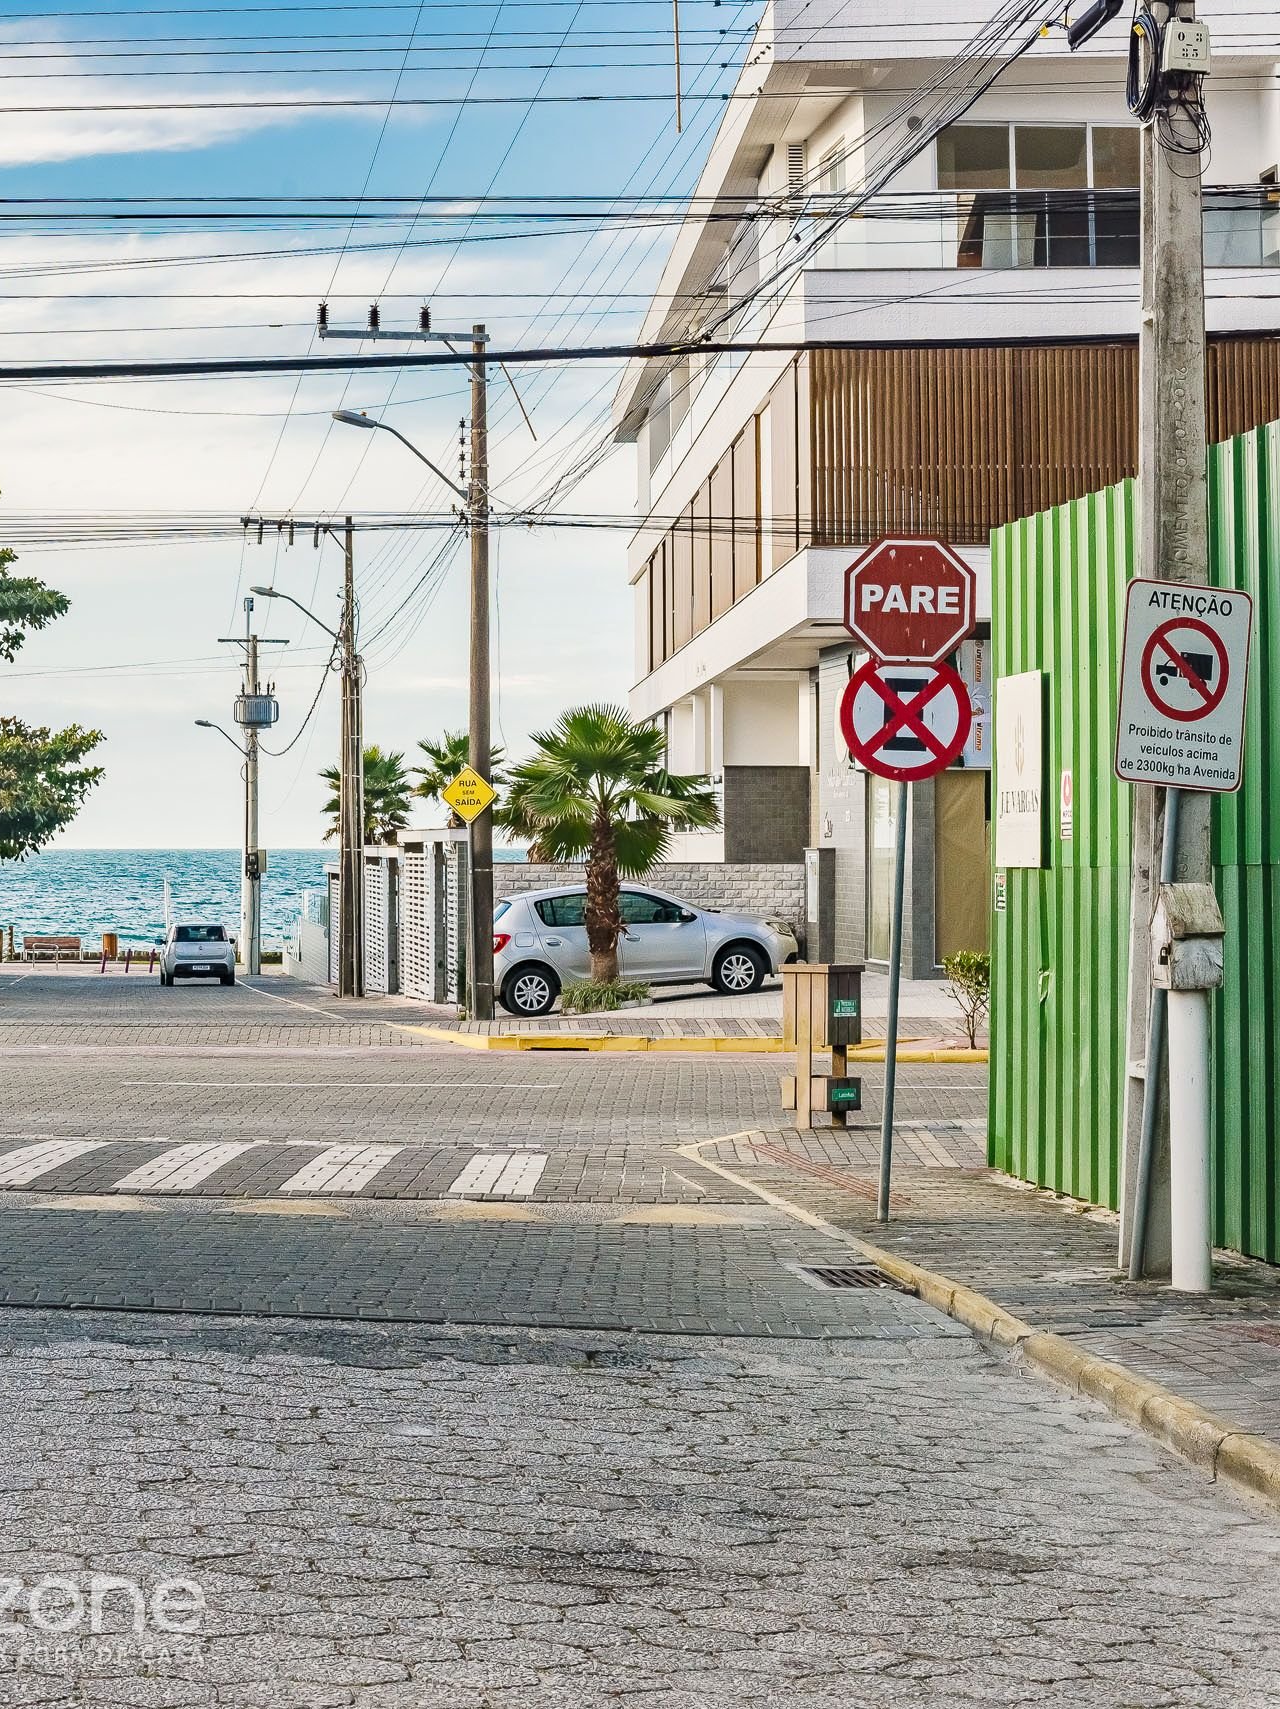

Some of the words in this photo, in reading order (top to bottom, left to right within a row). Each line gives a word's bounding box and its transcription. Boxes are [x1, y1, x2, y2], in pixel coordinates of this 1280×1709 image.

[861, 584, 960, 614] PARE
[1148, 590, 1233, 618] ATENÇÃO
[1128, 723, 1173, 739] Proibido
[1175, 728, 1217, 744] trânsito
[1219, 733, 1232, 746] de
[1186, 748, 1218, 762] acima
[1120, 758, 1134, 770] de
[1136, 759, 1175, 777] 2300kg
[1193, 765, 1236, 780] Avenida
[455, 797, 482, 806] SAÍDA
